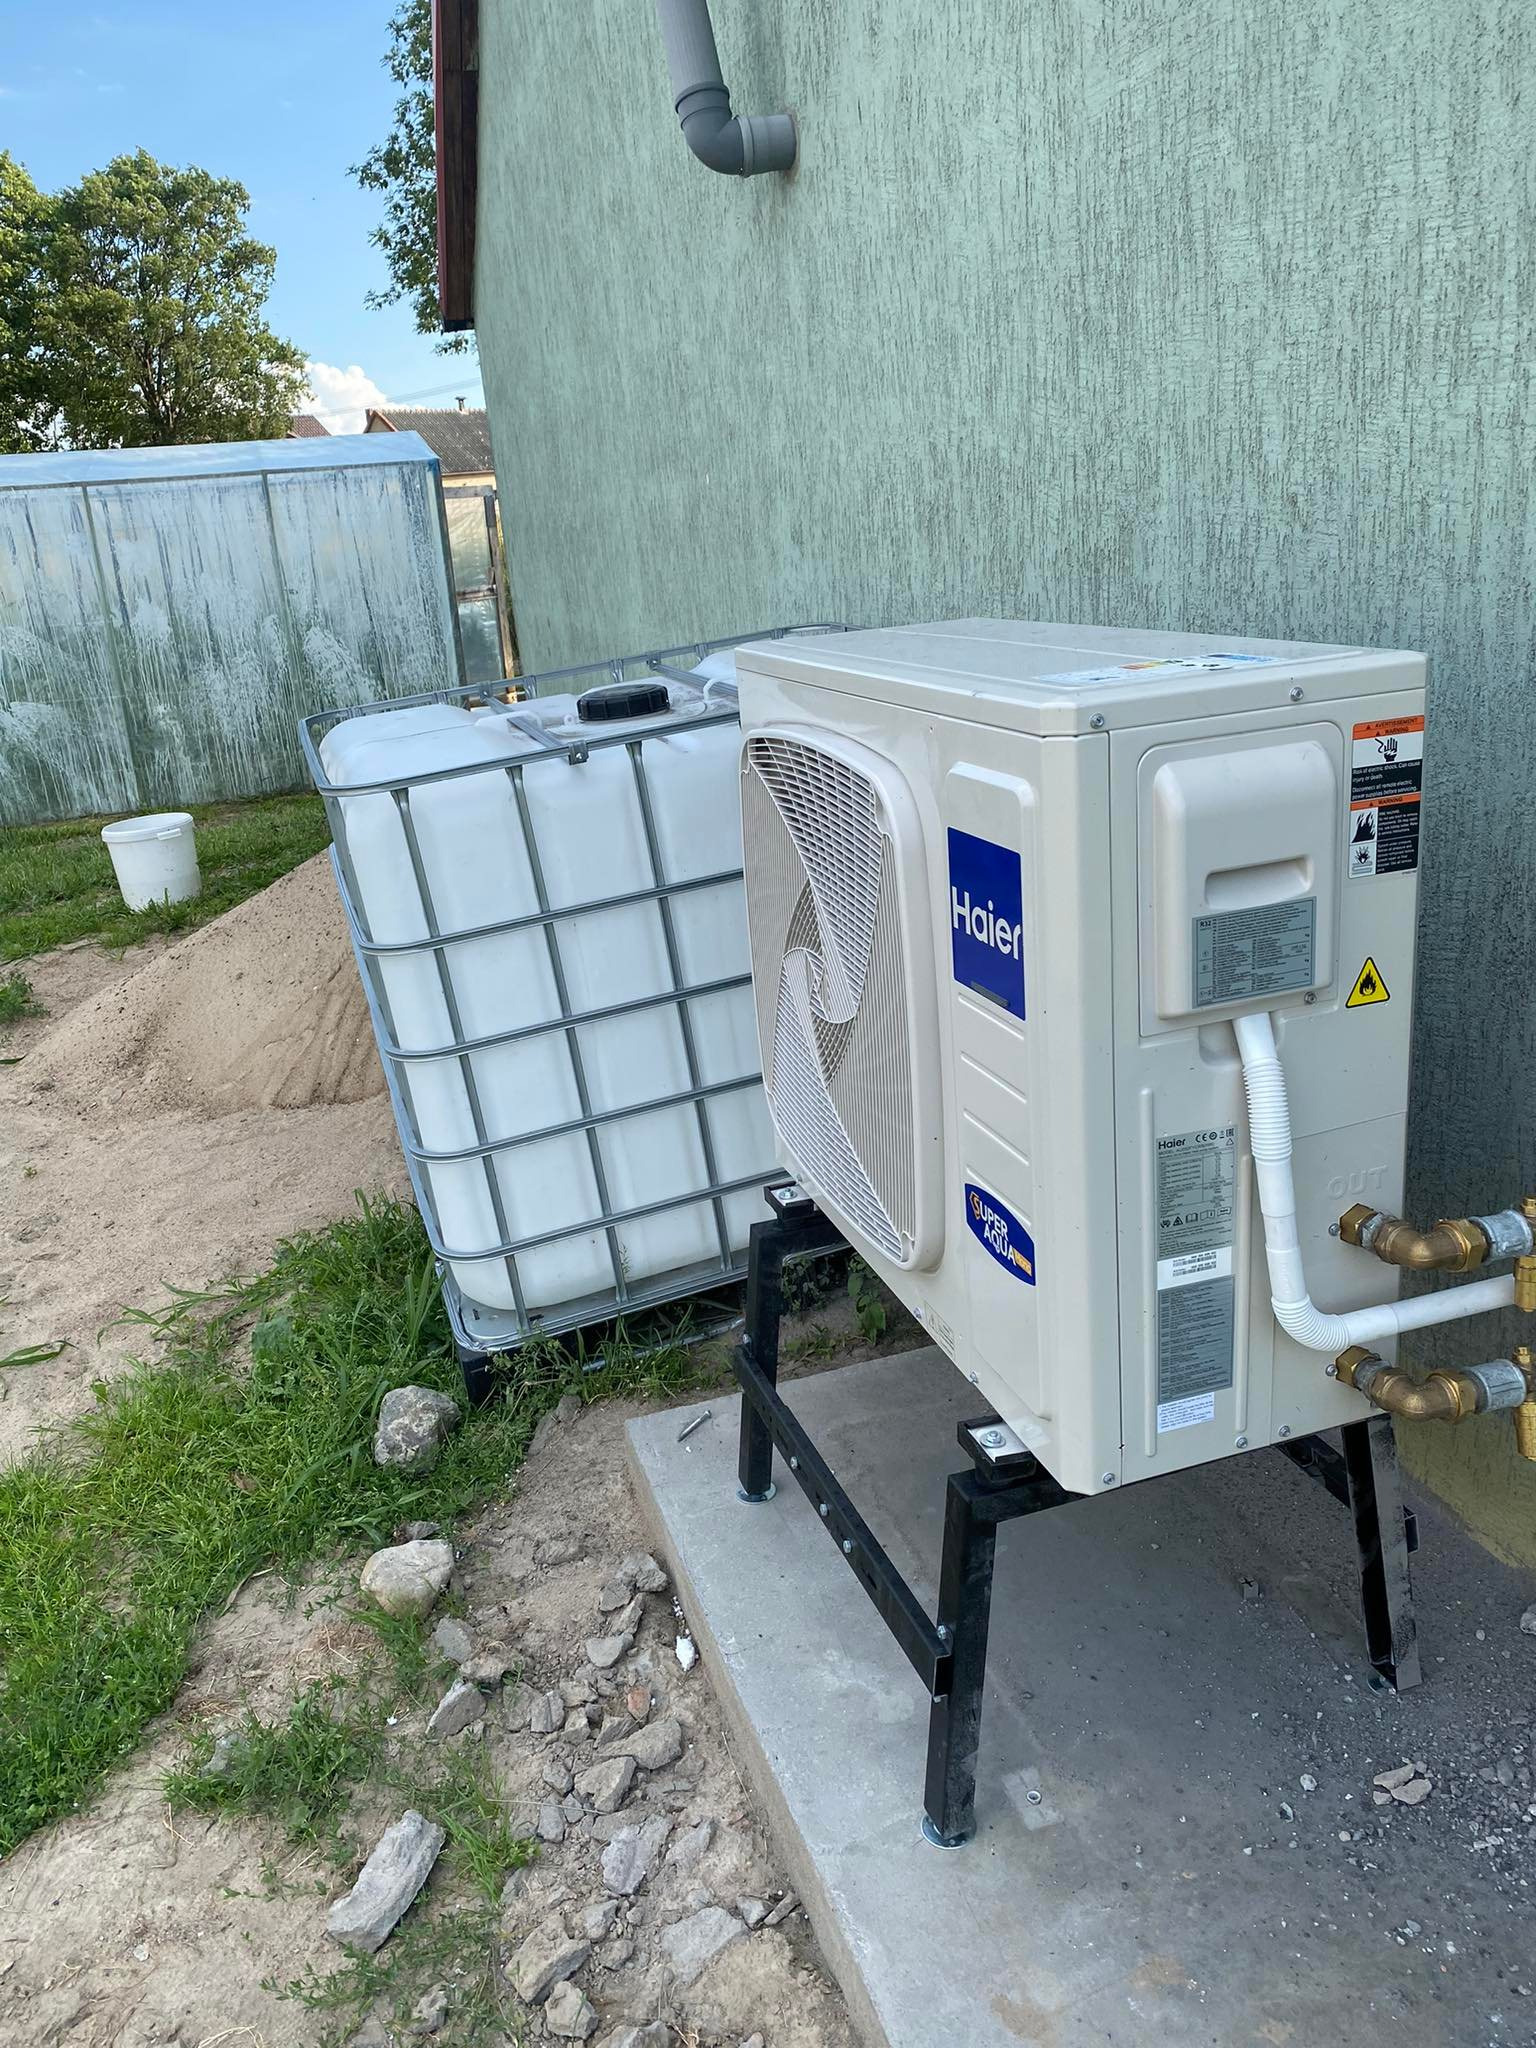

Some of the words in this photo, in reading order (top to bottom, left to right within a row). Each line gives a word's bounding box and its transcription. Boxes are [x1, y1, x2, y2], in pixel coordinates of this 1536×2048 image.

[1376, 718, 1418, 727] AVERTISSEMENT
[951, 885, 1021, 960] Haier
[1158, 1138, 1186, 1150] Haier
[1327, 1164, 1389, 1199] OUT
[970, 1191, 1008, 1240] SUPER
[984, 1224, 1017, 1266] AQUA
